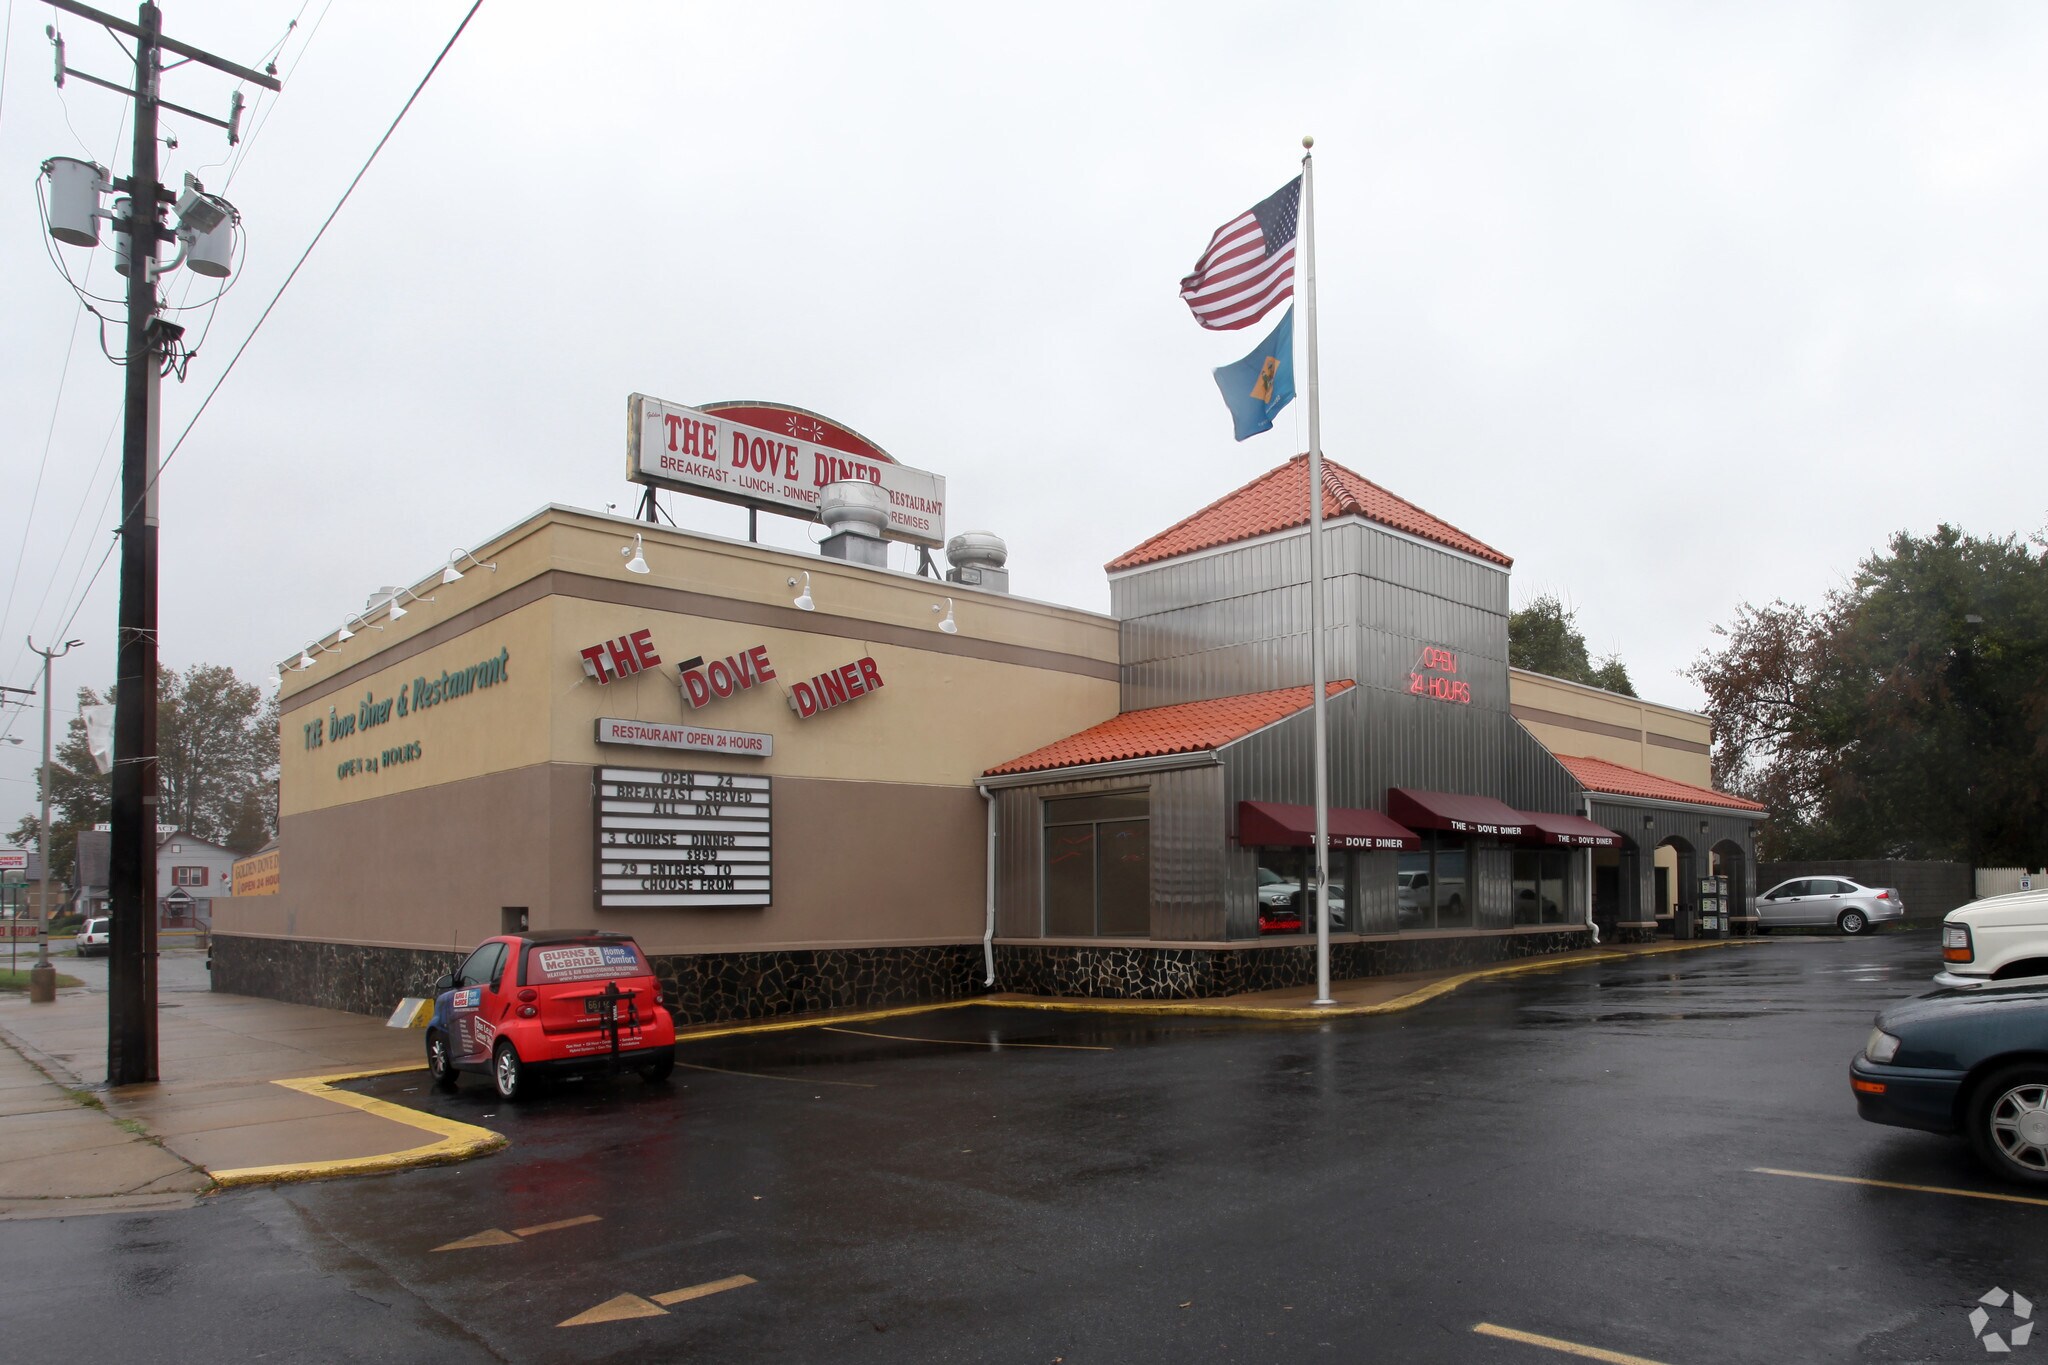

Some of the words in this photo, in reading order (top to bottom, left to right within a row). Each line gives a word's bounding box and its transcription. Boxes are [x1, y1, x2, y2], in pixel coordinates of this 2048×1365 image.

[664, 413, 717, 462] THE
[731, 431, 799, 482] DOVE
[660, 455, 729, 483] BREAKFAST
[739, 474, 775, 495] LUNCH
[889, 489, 943, 516] RESTAURANT
[889, 511, 930, 531] REMISES
[1424, 646, 1457, 674] OPEN
[580, 628, 662, 686] THE
[681, 644, 777, 710] DOVE
[791, 656, 885, 719] DINER
[1410, 672, 1425, 694] 24
[1429, 677, 1470, 703] HOURS
[303, 717, 323, 750] THE
[328, 708, 356, 743] Dove
[357, 691, 393, 732] Diner
[396, 683, 409, 718] &
[411, 646, 509, 713] Restaurant
[612, 725, 684, 743] RESTAURANT
[686, 732, 714, 746] OPEN
[716, 735, 727, 747] 24
[729, 736, 763, 751] HOURS
[337, 758, 363, 781] OPEN
[365, 757, 379, 774] 24
[382, 740, 422, 768] HOURS
[661, 771, 694, 786] OPEN
[717, 776, 734, 787] 24
[617, 786, 693, 801] BREAKFAST
[705, 790, 752, 803] SERVED
[653, 803, 679, 815] ALL
[696, 805, 722, 816] DAY
[1451, 820, 1467, 831] THE
[1477, 824, 1498, 834] DOVE
[1500, 826, 1522, 835] DINER
[608, 833, 616, 844] 3
[625, 833, 677, 845] COURSE
[691, 835, 735, 847] DINNER
[1346, 836, 1372, 847] DOVE
[1376, 838, 1403, 848] DINER
[1557, 834, 1570, 843] THE
[1578, 836, 1595, 845] DOVE
[1596, 837, 1613, 845] DINER
[687, 849, 718, 861] $899
[621, 863, 638, 875] 29
[651, 864, 706, 876] ENTREES
[715, 864, 732, 875] TO
[641, 879, 694, 891] CHOOSE
[700, 879, 735, 891] FROM
[543, 948, 586, 961] BURNS
[588, 948, 597, 957] &
[602, 947, 625, 955] Home
[545, 956, 602, 970] McBRIDE
[606, 955, 636, 964] Comfort
[547, 969, 568, 978] HEATING
